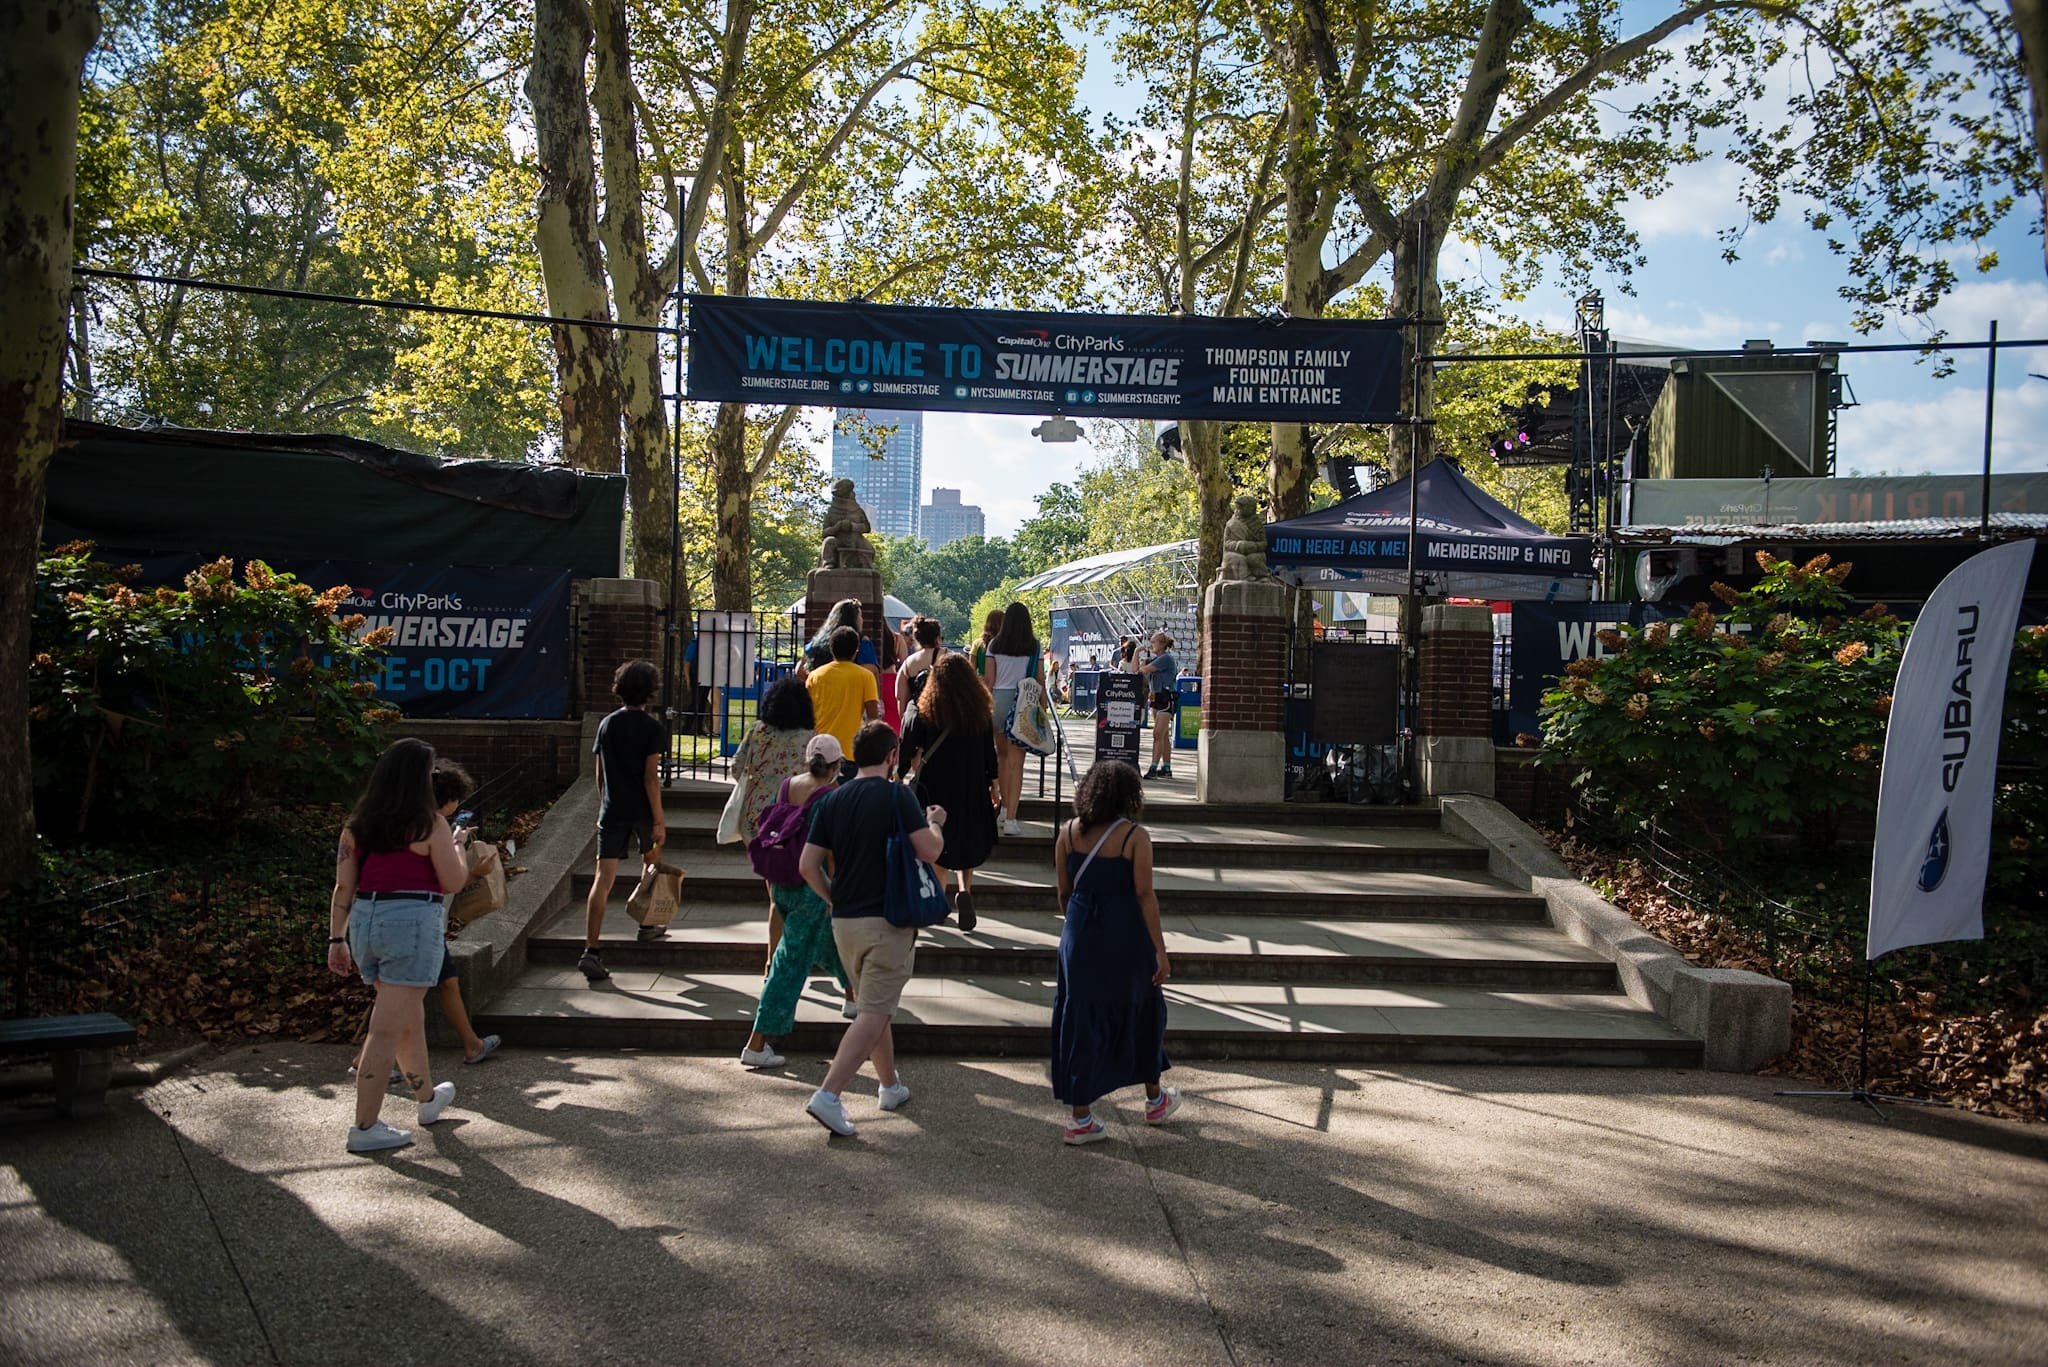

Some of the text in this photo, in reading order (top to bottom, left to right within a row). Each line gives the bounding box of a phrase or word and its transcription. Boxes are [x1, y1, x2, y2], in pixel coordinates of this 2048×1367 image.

[1055, 333, 1124, 353] CityParks
[745, 335, 982, 379] WELCOME TO
[1205, 347, 1351, 368] THOMPSON FAMILY
[995, 353, 1181, 386] SUMMERSTAGE
[1229, 367, 1325, 386] FOUNDATION
[741, 376, 1181, 405] SUMMERSTAGE.ORG SUMMERSTAGE NYCSUMMERSTAGE SUMMERSTAGENYC
[1213, 386, 1341, 405] MAIN ENTRANCE
[1271, 537, 1406, 557] JOIN HERE! ASK ME!
[1427, 542, 1571, 565] MEMBERSHIP & INFO
[381, 592, 463, 613] CityParks
[1943, 605, 1980, 793] SUBARU
